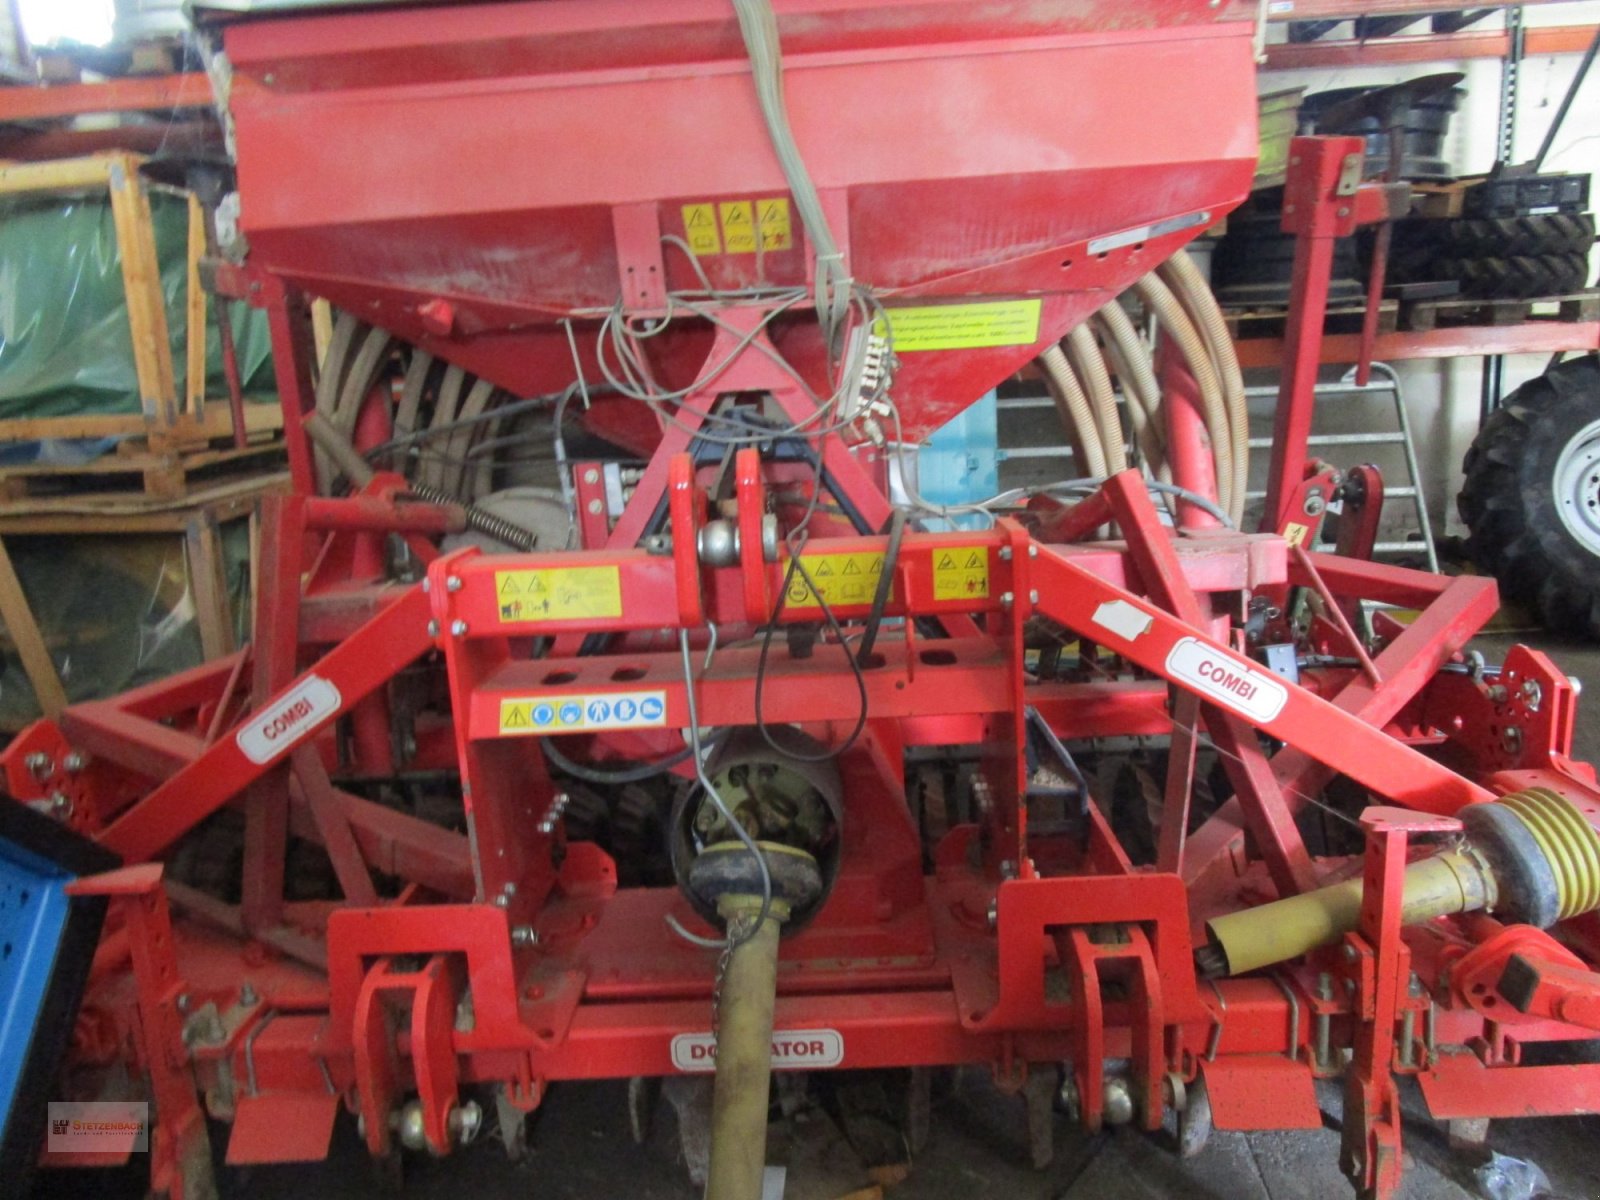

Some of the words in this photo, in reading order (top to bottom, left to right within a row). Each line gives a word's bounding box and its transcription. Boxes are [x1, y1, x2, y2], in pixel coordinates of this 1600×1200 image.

[1198, 661, 1257, 701] COMBI
[263, 697, 314, 740] COMBI
[690, 1041, 825, 1060] DOATOR
